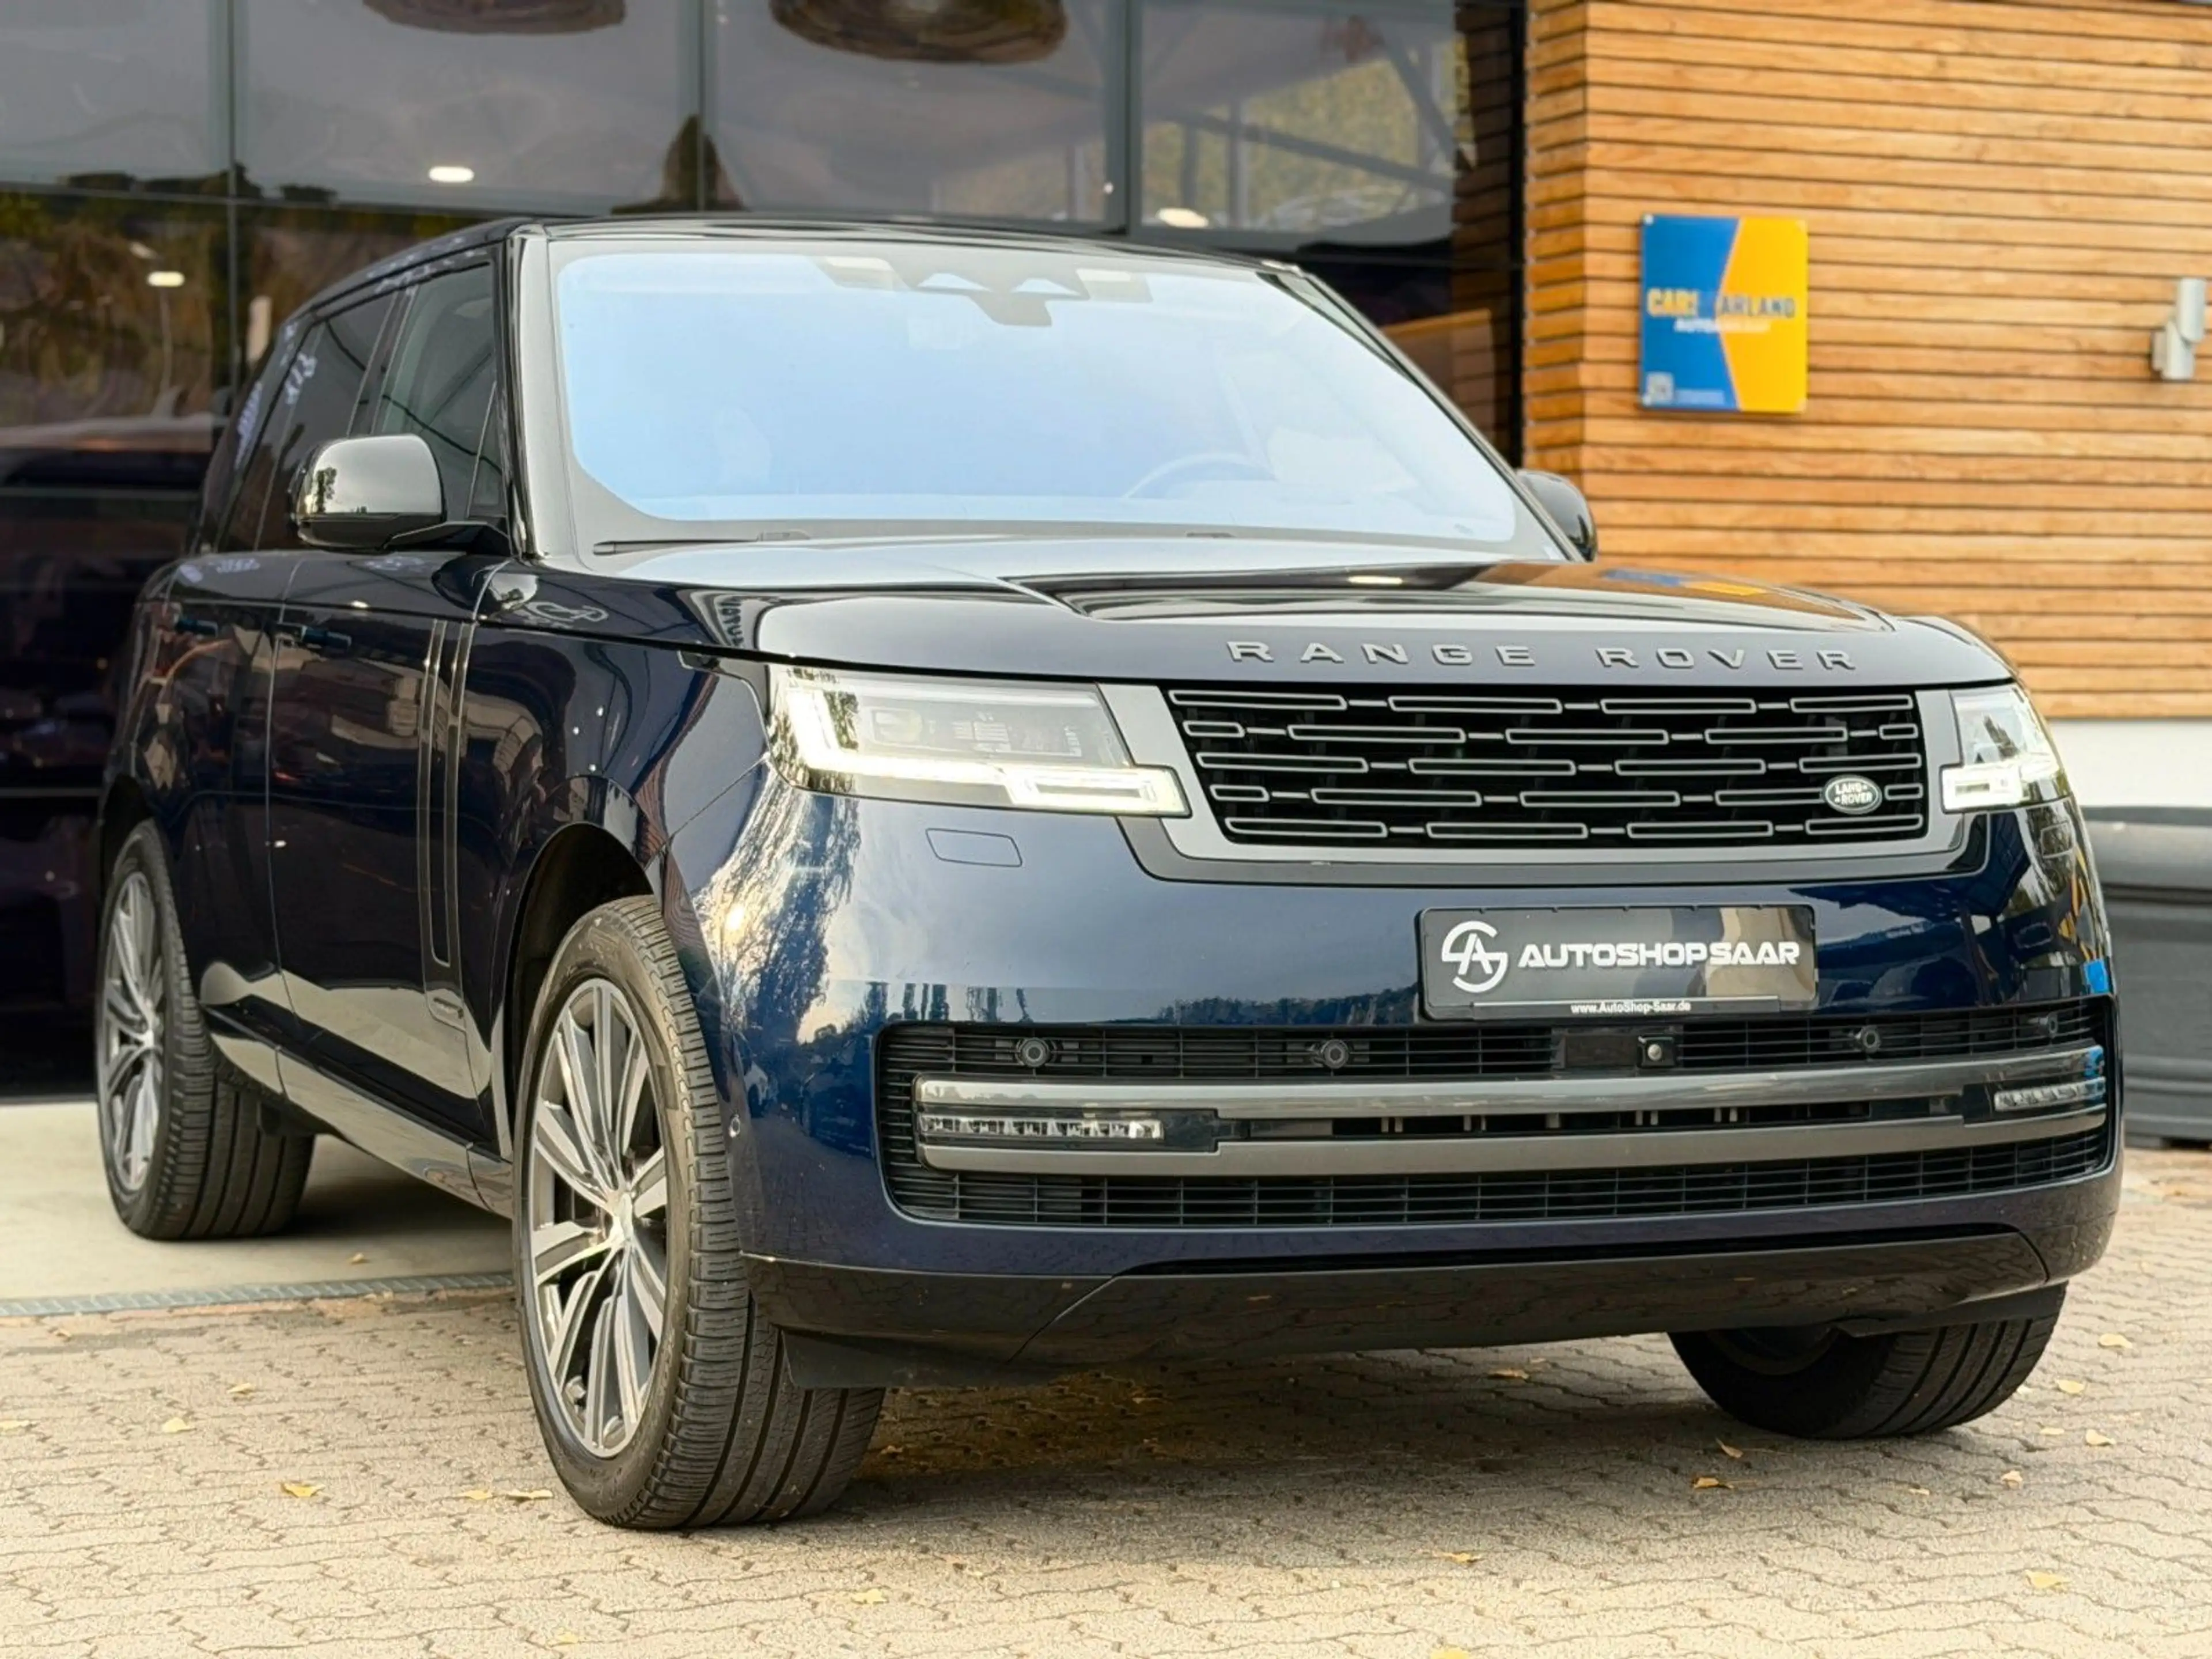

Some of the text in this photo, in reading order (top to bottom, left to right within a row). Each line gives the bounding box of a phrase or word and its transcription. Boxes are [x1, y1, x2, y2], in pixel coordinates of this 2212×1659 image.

[1226, 641, 1856, 670] RANGE ROVER
[1835, 782, 1862, 795] LAND
[1841, 791, 1873, 805] ROVER
